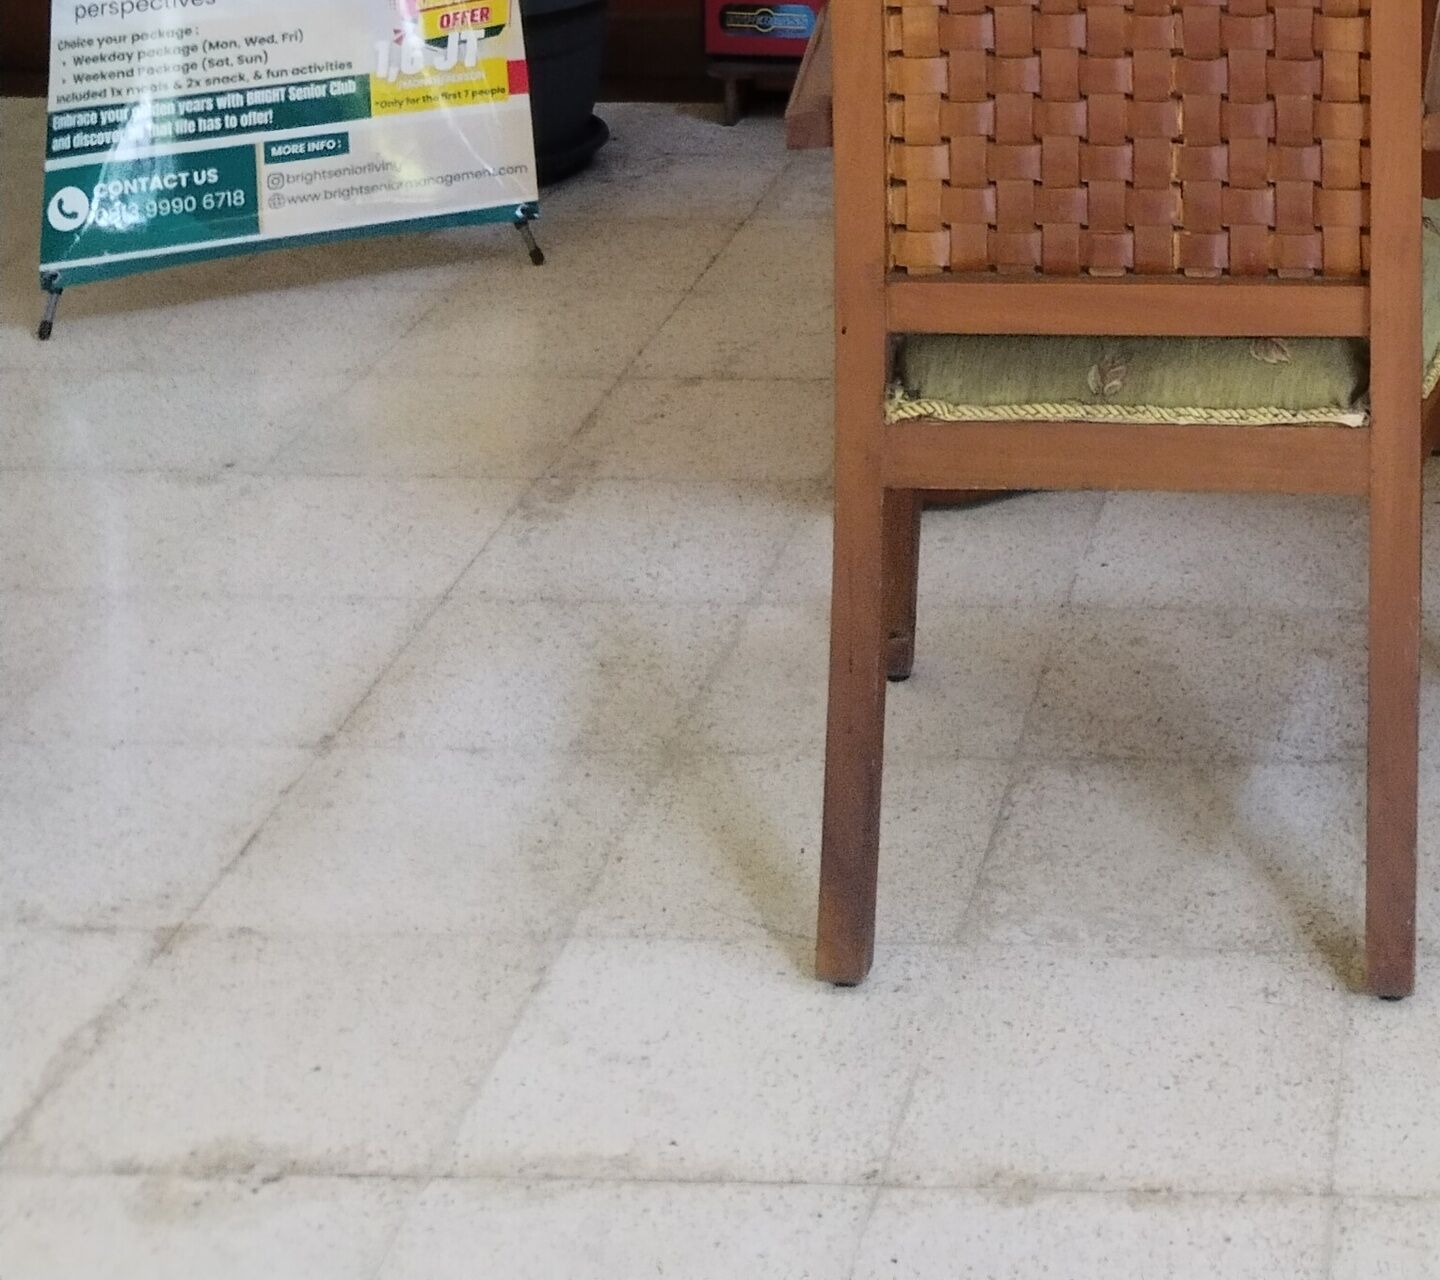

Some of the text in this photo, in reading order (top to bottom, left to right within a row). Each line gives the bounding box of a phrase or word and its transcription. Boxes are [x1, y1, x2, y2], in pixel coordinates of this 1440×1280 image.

[440, 6, 491, 29] OFFER
[72, 51, 134, 67] Weekday
[137, 44, 198, 61] package
[281, 28, 304, 44] Fri)
[97, 35, 127, 48] your
[131, 27, 193, 44] package
[72, 68, 134, 84] Weekend
[237, 50, 269, 64] Sun)
[187, 78, 201, 89] 2x
[253, 70, 262, 80] &
[266, 68, 289, 80] fun
[291, 60, 354, 76] activities
[52, 111, 98, 131] Embrace
[100, 107, 130, 126] your
[178, 97, 214, 116] years
[215, 93, 244, 110] with
[246, 87, 286, 106] BRIGHT
[287, 83, 328, 102] Senior
[329, 79, 357, 96] Club
[471, 86, 506, 100] people
[51, 134, 71, 152] and
[197, 115, 222, 133] has
[224, 114, 238, 128] to
[240, 109, 274, 128] offer!
[270, 143, 305, 157] MORE
[95, 168, 219, 199] CONTACT US
[202, 190, 246, 210] 6718
